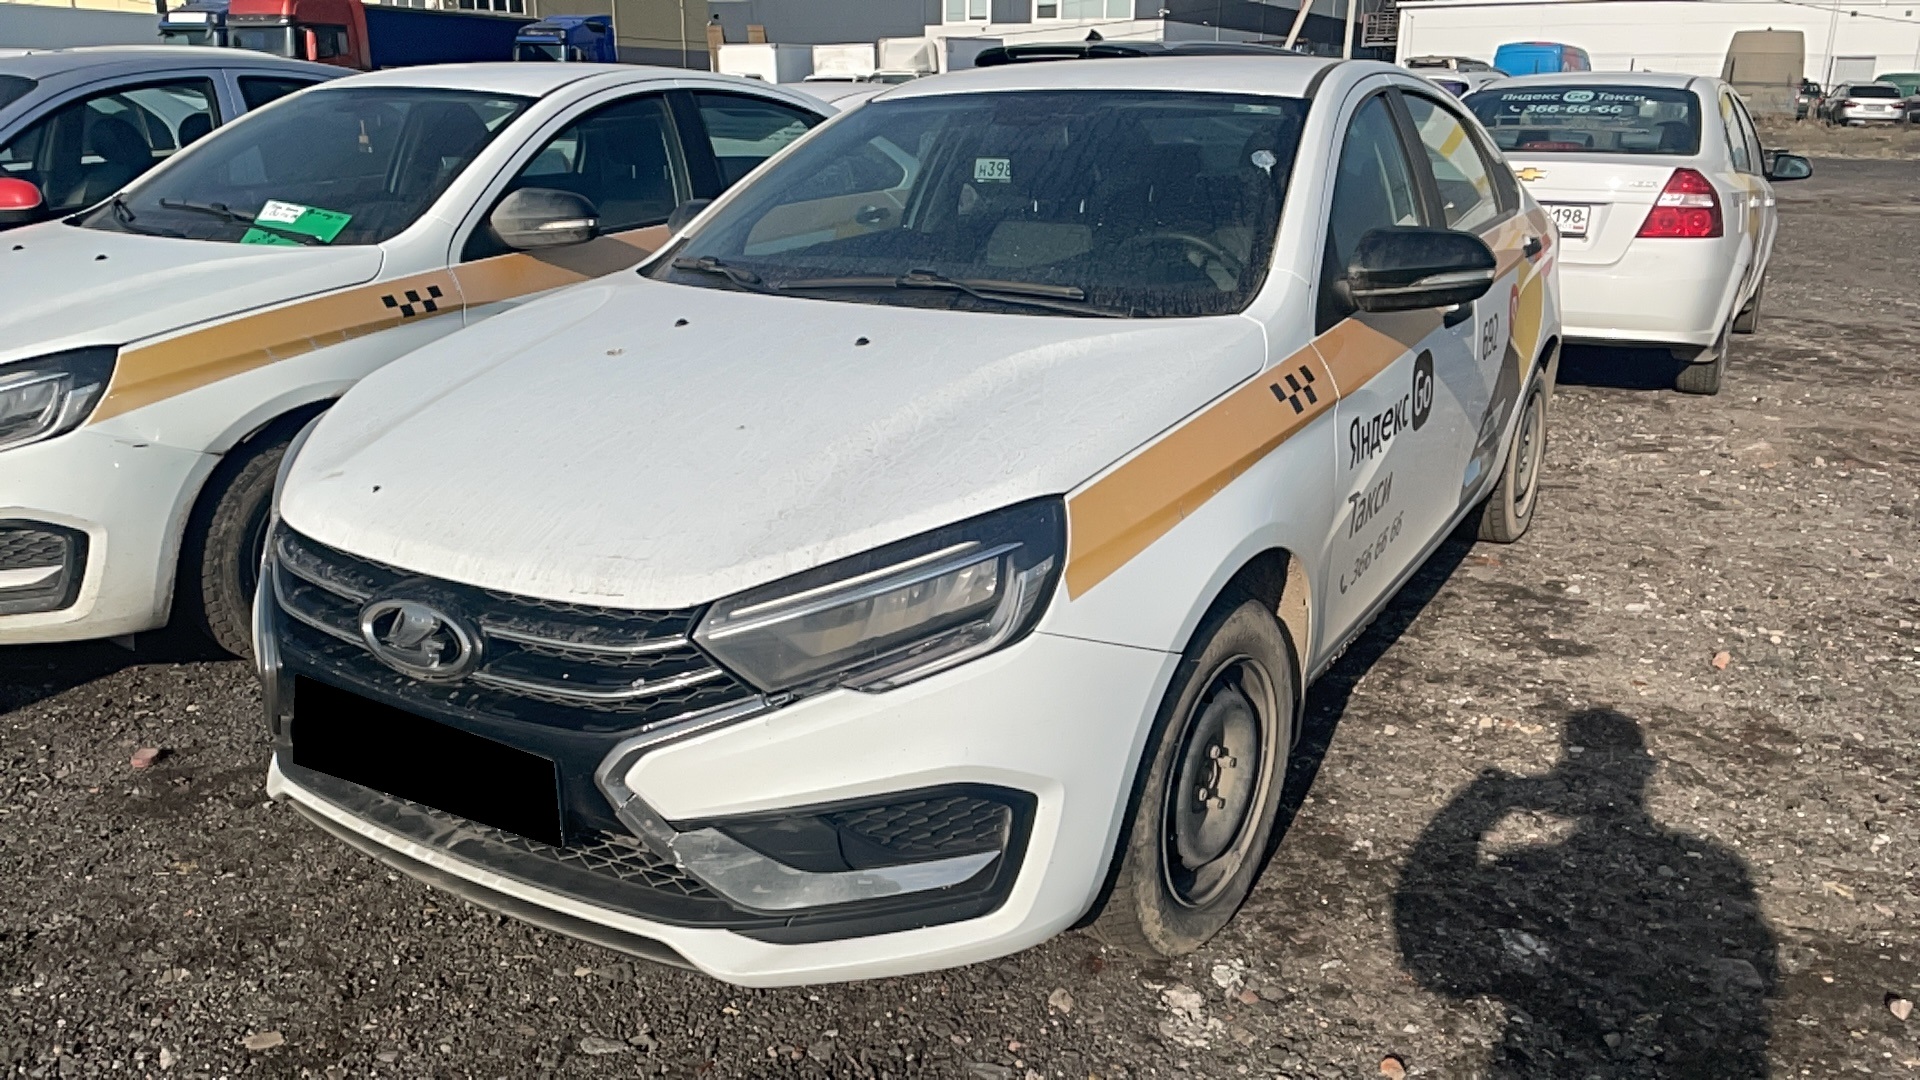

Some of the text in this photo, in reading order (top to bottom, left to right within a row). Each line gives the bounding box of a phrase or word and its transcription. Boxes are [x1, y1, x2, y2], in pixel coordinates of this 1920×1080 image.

[1501, 93, 1561, 102] Яндекс
[1598, 92, 1646, 102] Такси
[1526, 104, 1623, 114] 366-66-66
[1552, 208, 1583, 224] 198
[1482, 312, 1498, 361] 692
[1349, 393, 1410, 471] Яндекс
[1348, 471, 1393, 540] Такси
[1350, 510, 1404, 586] 366 66 66
